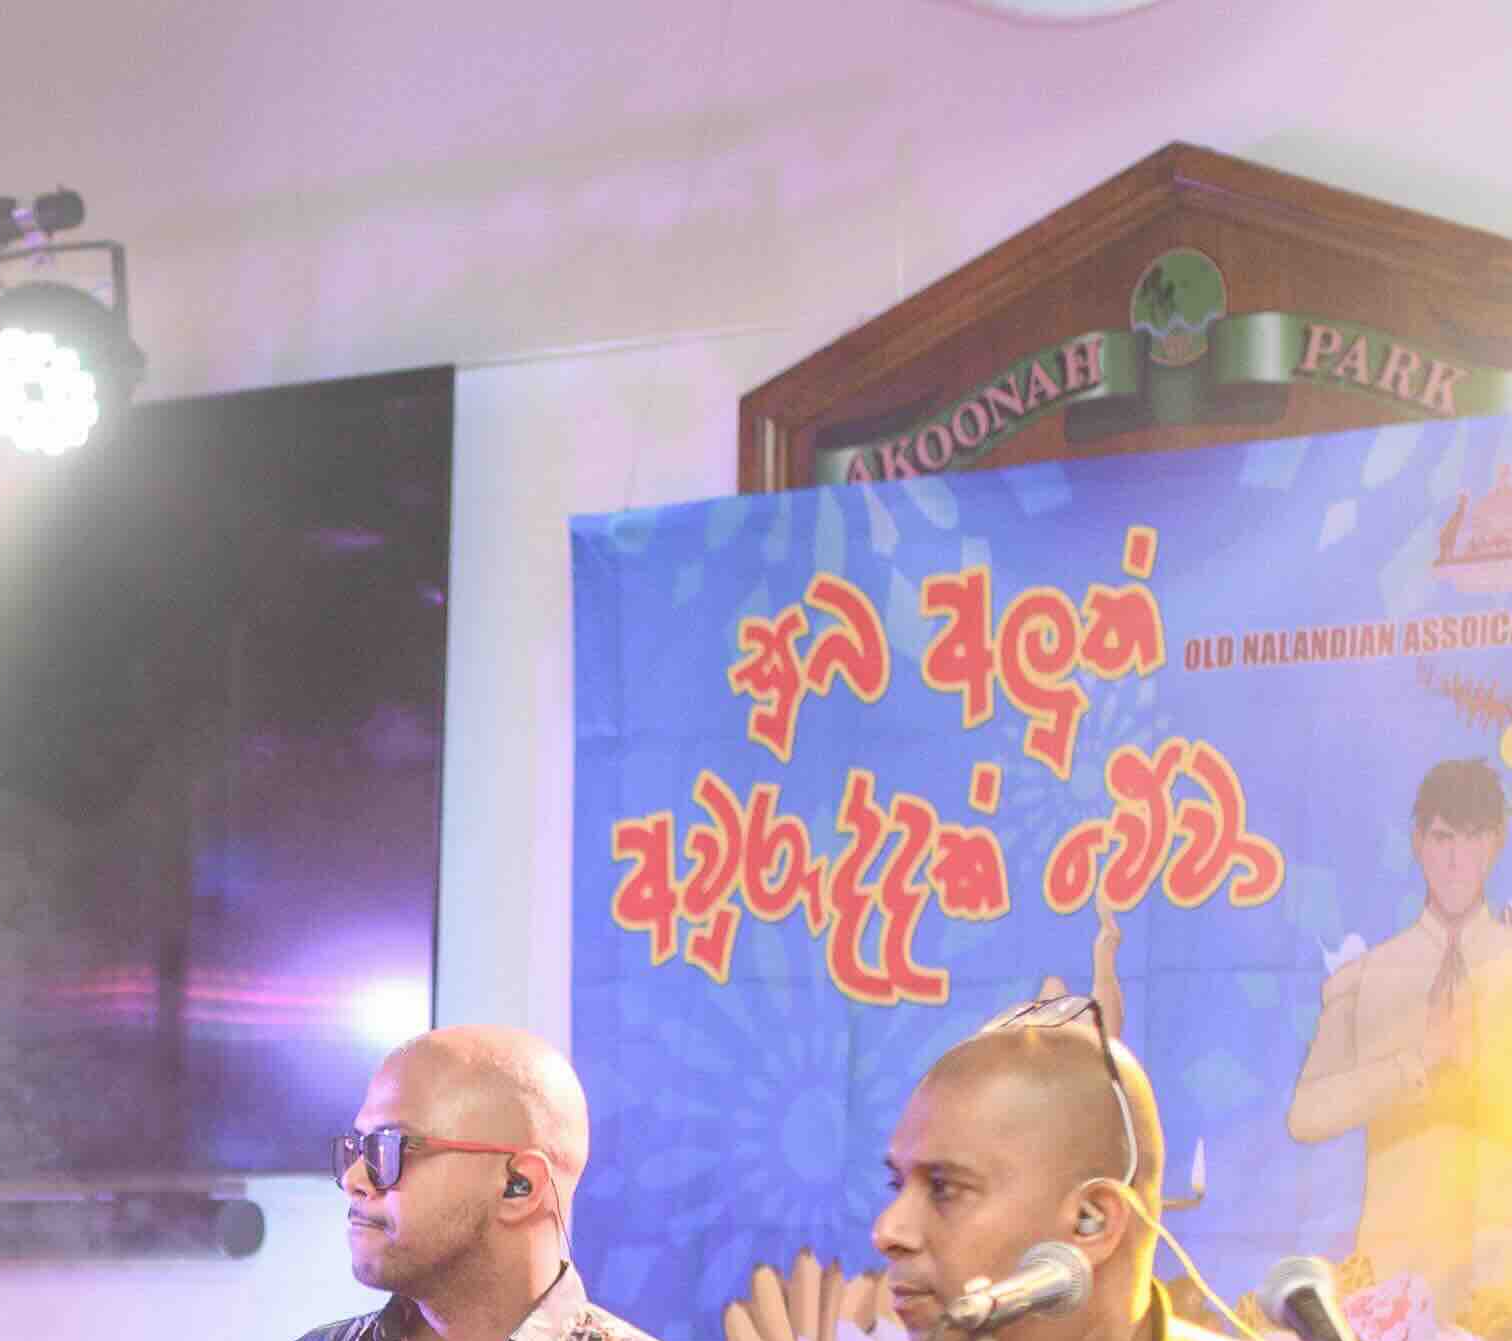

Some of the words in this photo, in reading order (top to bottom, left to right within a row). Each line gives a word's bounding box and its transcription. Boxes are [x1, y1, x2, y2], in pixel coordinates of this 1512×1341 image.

[1301, 323, 1464, 416] PARK
[1183, 637, 1234, 672] OLD
[1241, 622, 1396, 667] NALANDIAN
